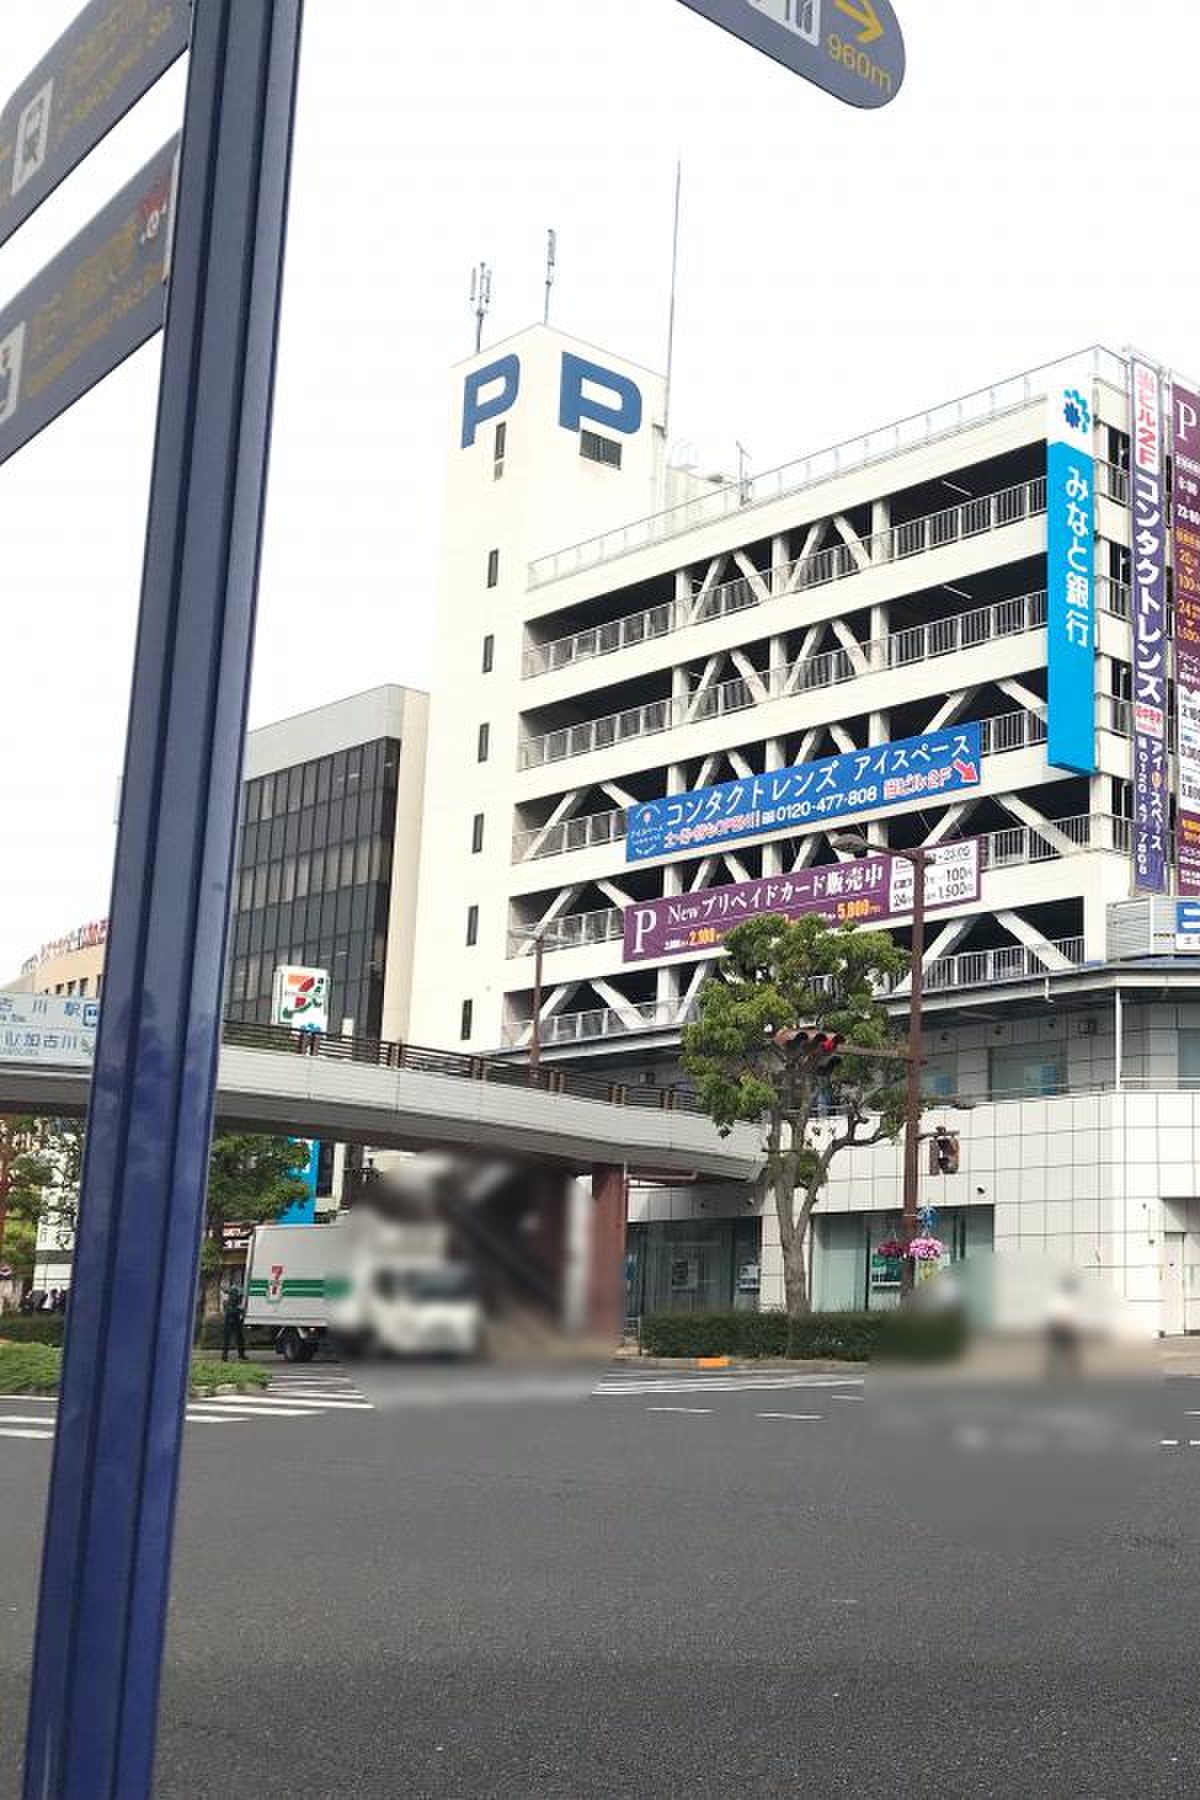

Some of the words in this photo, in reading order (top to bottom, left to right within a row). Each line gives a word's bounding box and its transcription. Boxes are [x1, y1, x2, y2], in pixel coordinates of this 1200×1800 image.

[828, 32, 893, 96] 960m
[461, 353, 520, 450] P
[559, 350, 642, 435] P
[1176, 399, 1197, 441] P
[1064, 466, 1090, 648] みなと銀行
[1135, 474, 1162, 704] コンタクトレンズ
[666, 760, 839, 826] コンタクトレンズ
[854, 735, 970, 782] アイスペース
[777, 785, 877, 821] 0120-477-808
[632, 908, 656, 954] P
[667, 905, 698, 926] New
[701, 862, 882, 916] プリペイドカード販売中
